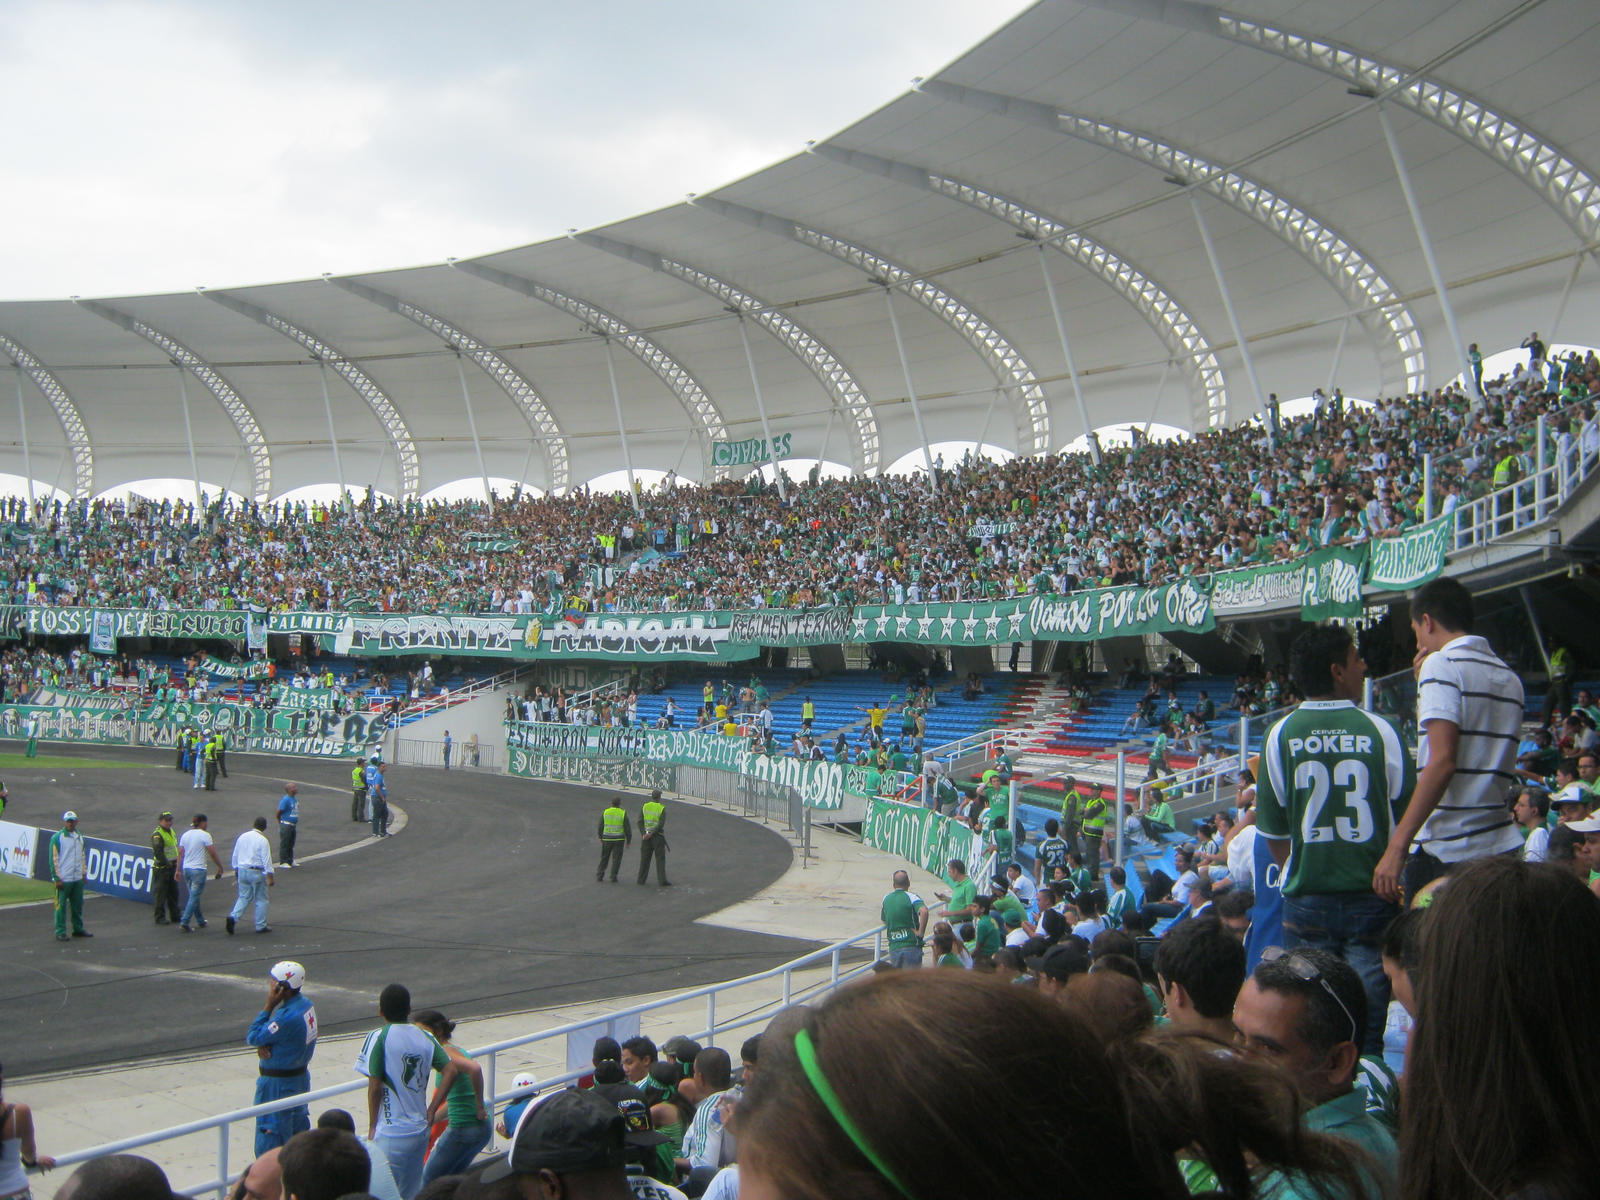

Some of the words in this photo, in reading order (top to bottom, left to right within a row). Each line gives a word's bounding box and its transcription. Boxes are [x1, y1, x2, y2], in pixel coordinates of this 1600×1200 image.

[268, 613, 345, 632] PALMIRA
[351, 615, 517, 651] FRENTE
[551, 614, 718, 654] RADICAL
[1288, 735, 1372, 757] POKER
[1294, 759, 1374, 843] 23
